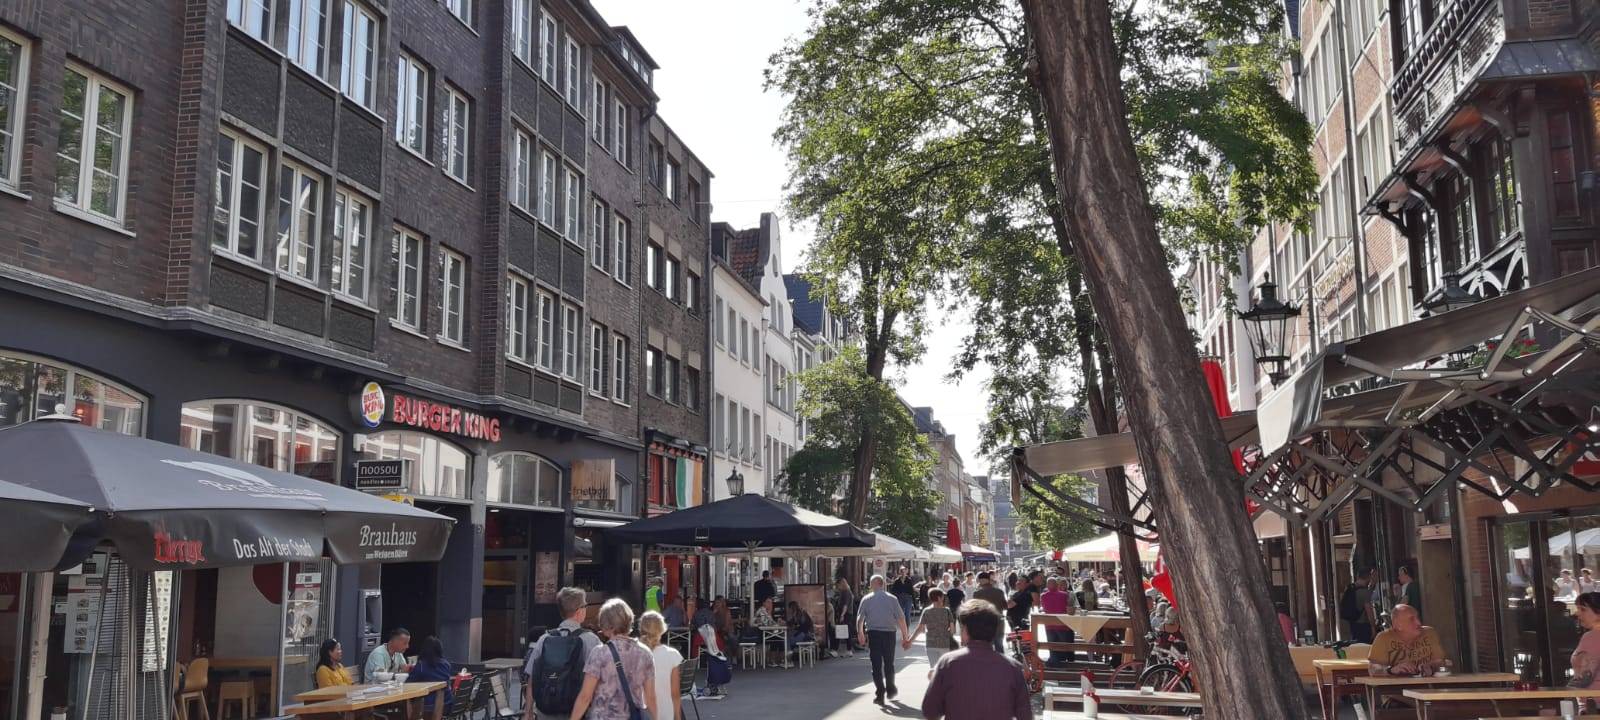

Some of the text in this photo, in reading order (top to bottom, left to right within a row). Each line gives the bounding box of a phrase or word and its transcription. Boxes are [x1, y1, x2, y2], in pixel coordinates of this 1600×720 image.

[393, 394, 501, 443] BURGER KING
[360, 465, 398, 475] noosou
[360, 522, 417, 547] Brauhaus
[233, 538, 257, 559] Das
[258, 536, 273, 558] Alt
[275, 536, 290, 557] der
[289, 537, 315, 558] Stadt
